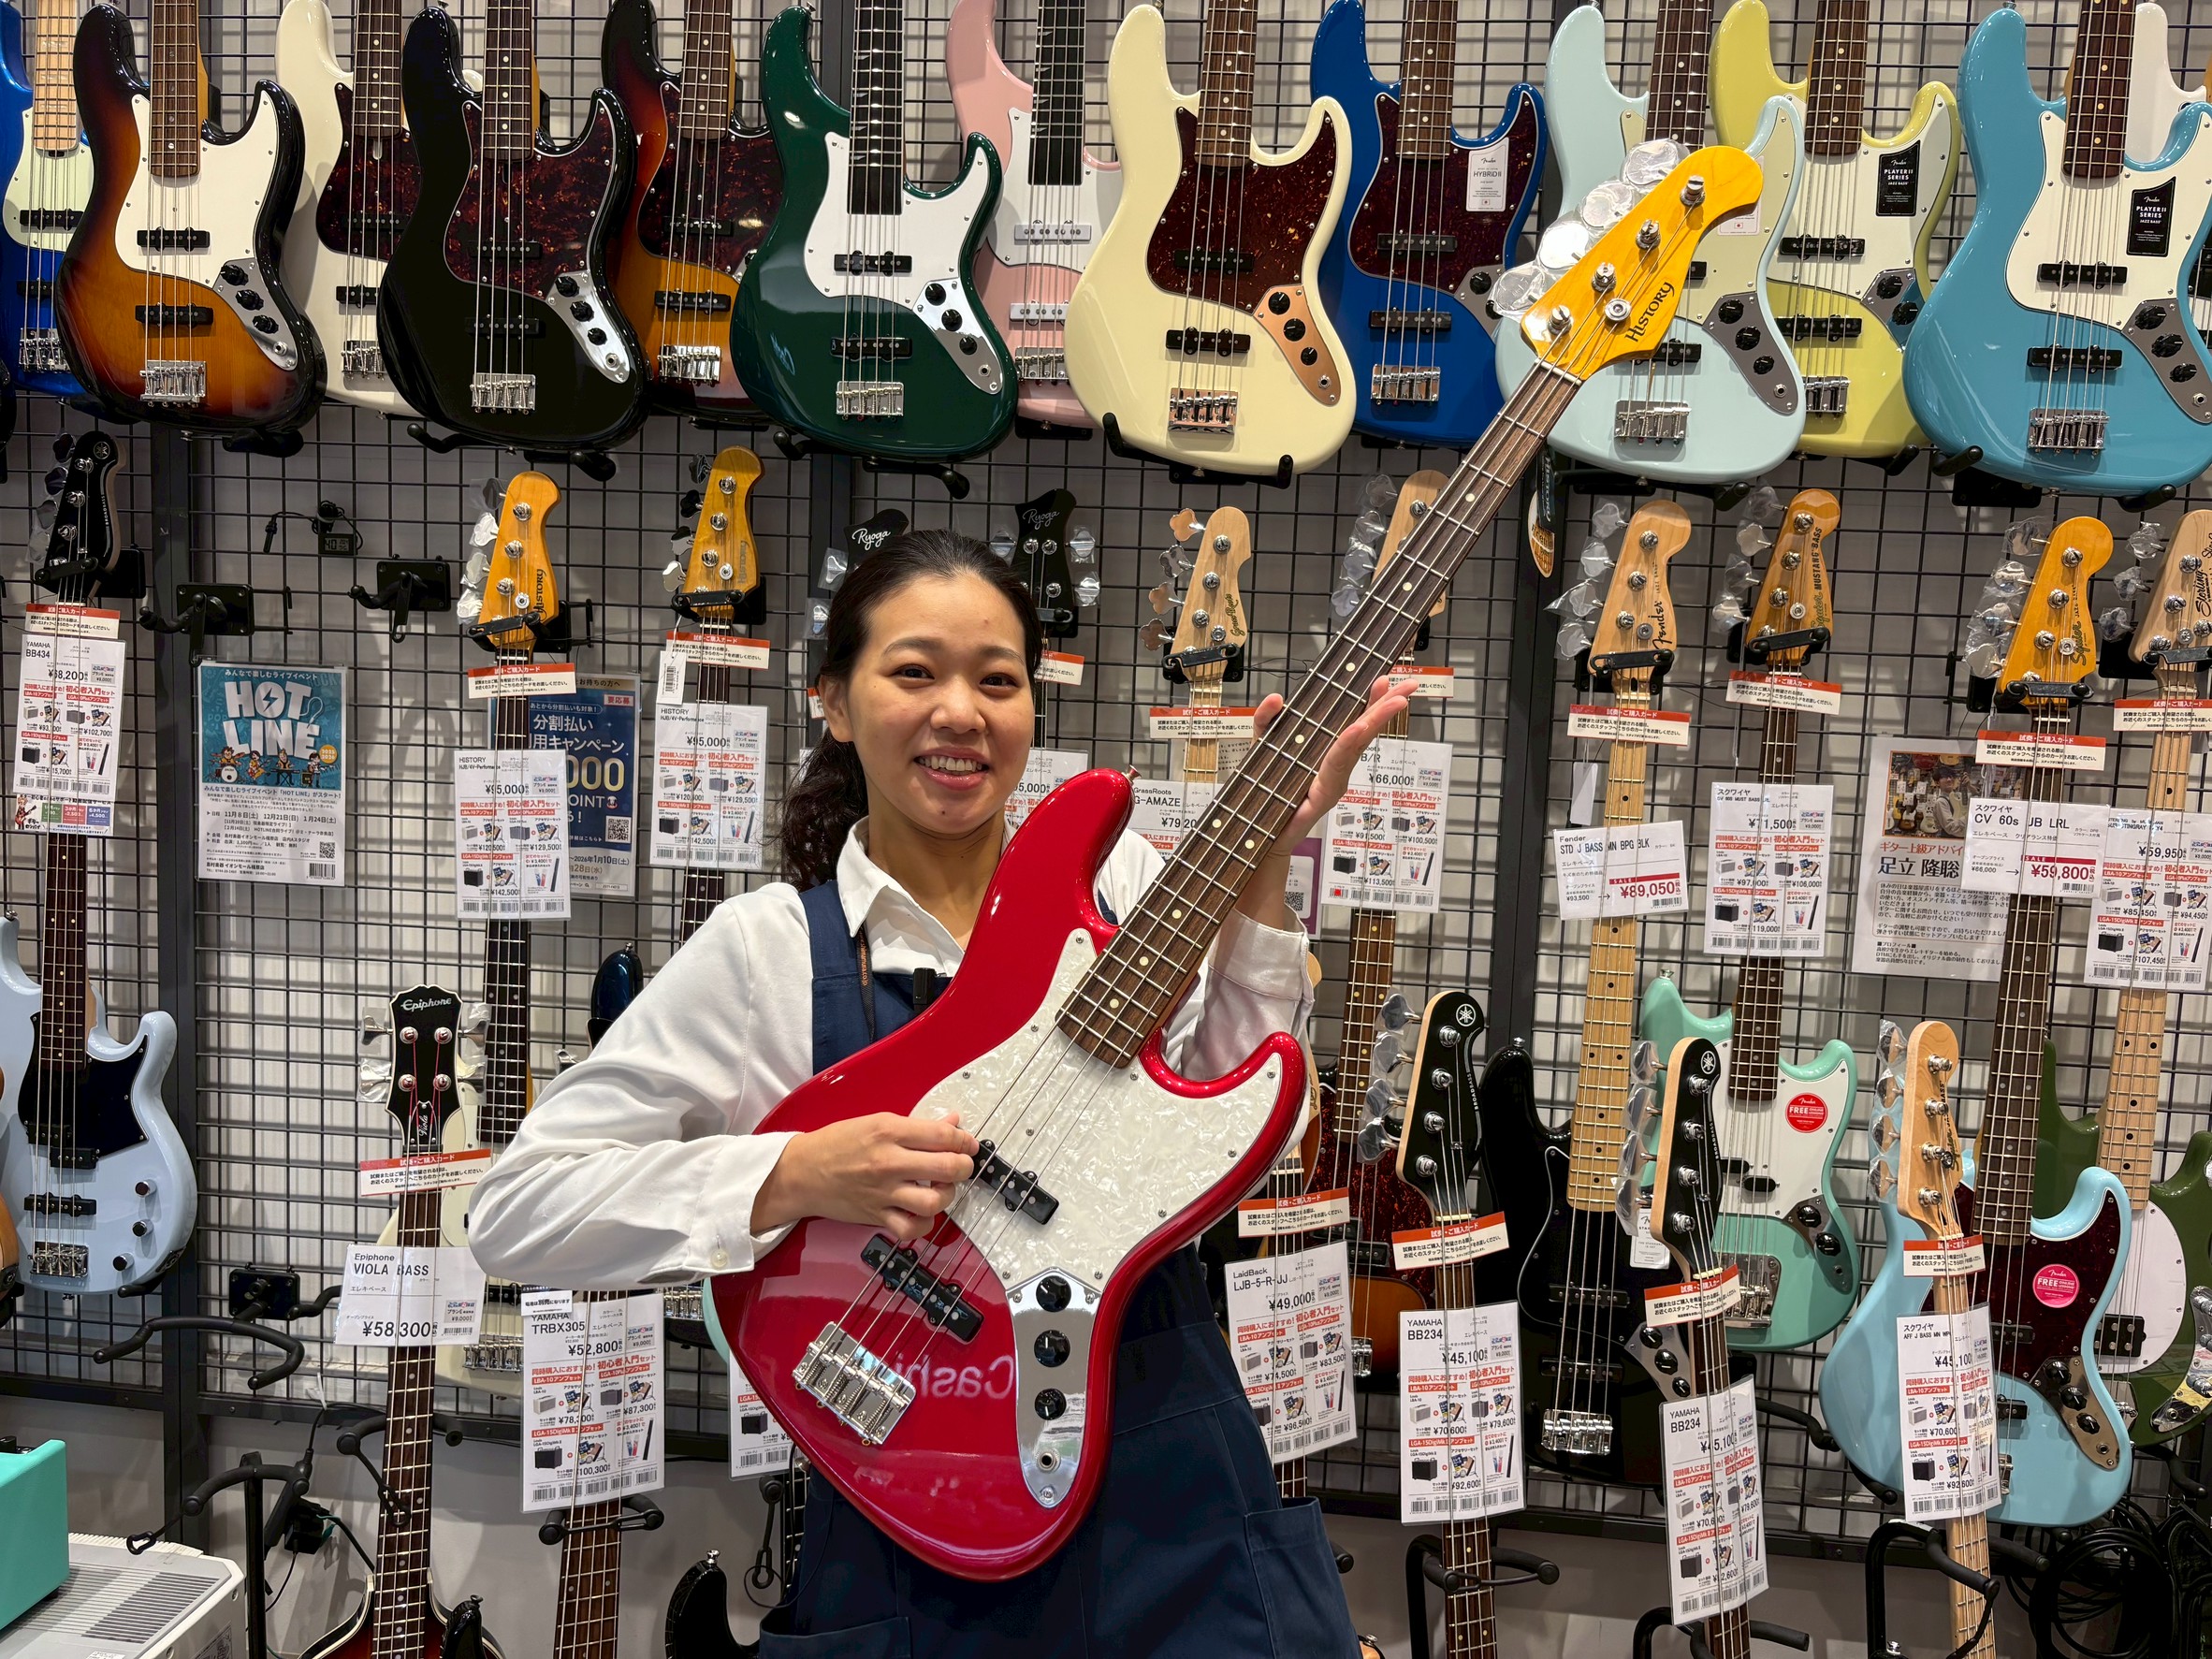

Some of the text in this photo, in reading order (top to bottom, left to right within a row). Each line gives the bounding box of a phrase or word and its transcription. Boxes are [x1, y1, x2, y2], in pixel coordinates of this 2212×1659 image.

[1624, 282, 1675, 342] HISTORY
[1022, 508, 1060, 531] Ryoga
[851, 527, 891, 550] Ryoga
[737, 540, 748, 585] HISTORY
[1812, 527, 1823, 590] MUSTANG BASS
[534, 567, 547, 621] HISTORY
[1648, 601, 1672, 650] Fender
[2071, 621, 2090, 666] Squier
[25, 649, 51, 659] BB434
[225, 669, 318, 681] みんなで楽しむライブイベント
[225, 680, 312, 720] HOT
[607, 695, 631, 705] 要応募
[661, 707, 690, 716] HISTORY
[533, 714, 594, 733] 分割払い
[83, 729, 110, 737] ¥102,700
[223, 719, 320, 761] LINE
[529, 734, 625, 753] 用キャンペーン
[687, 735, 727, 748] ¥95,000
[707, 752, 760, 762] 初心者入門セット
[1369, 773, 1411, 786] ¥66,000
[1134, 787, 1172, 795] GrassRoots
[1391, 791, 1441, 801] 初心者入門セット
[506, 799, 560, 808] 初心者入門セット
[1134, 796, 1181, 808] G-AMAZE
[1975, 804, 2013, 813] スクワイヤ
[263, 813, 299, 822] 12月21日(日)
[303, 816, 337, 824] 1月24日(土)
[1974, 813, 2070, 829] CV 60s JB LRL
[1773, 835, 1825, 844] 初心者入門セット
[2015, 833, 2059, 841] クリアランス特価
[1560, 838, 1650, 854] STD J BASS MN BPG BLK
[1880, 841, 1964, 856] ギター上級アドバイ
[2138, 846, 2183, 859] ¥59,950
[1877, 856, 1960, 879] 足立 隆聡
[2030, 864, 2089, 880] ¥59,800
[1620, 880, 1675, 899] ¥89,050
[1792, 880, 1820, 888] ¥106,000
[2180, 911, 2205, 920] ¥94,450
[400, 997, 452, 1012] Epiphone
[1789, 1106, 1809, 1114] FREE
[419, 1114, 429, 1136] Viola
[355, 1253, 395, 1261] Epiphone
[354, 1263, 429, 1275] VIOLA BASS
[1233, 1268, 1268, 1279] LaidBack
[1233, 1273, 1288, 1291] LJB-5-R-JJ
[2037, 1278, 2059, 1287] FREE
[531, 1313, 570, 1322] YAMAHA
[1296, 1304, 1344, 1323] 初心者入門セット
[531, 1321, 586, 1334] TRBX305
[592, 1321, 623, 1331] エレキベース
[1407, 1318, 1443, 1327] YAMAHA
[1903, 1323, 1934, 1332] スクワイヤ
[1407, 1329, 1443, 1341] BB234
[568, 1340, 618, 1356] ¥52,800
[597, 1354, 657, 1370] 初心者入門セット
[1319, 1356, 1345, 1368] ¥83,500
[1442, 1348, 1485, 1364] ¥45,100
[1264, 1370, 1294, 1381] ¥74,500
[1468, 1365, 1515, 1379] 初心者入門セット
[623, 1404, 654, 1416] ¥87,300
[1669, 1406, 1700, 1419] YAMAHA
[1489, 1418, 1514, 1429] ¥79,600
[1670, 1418, 1701, 1433] BB234
[1451, 1481, 1479, 1491] ¥92,600
